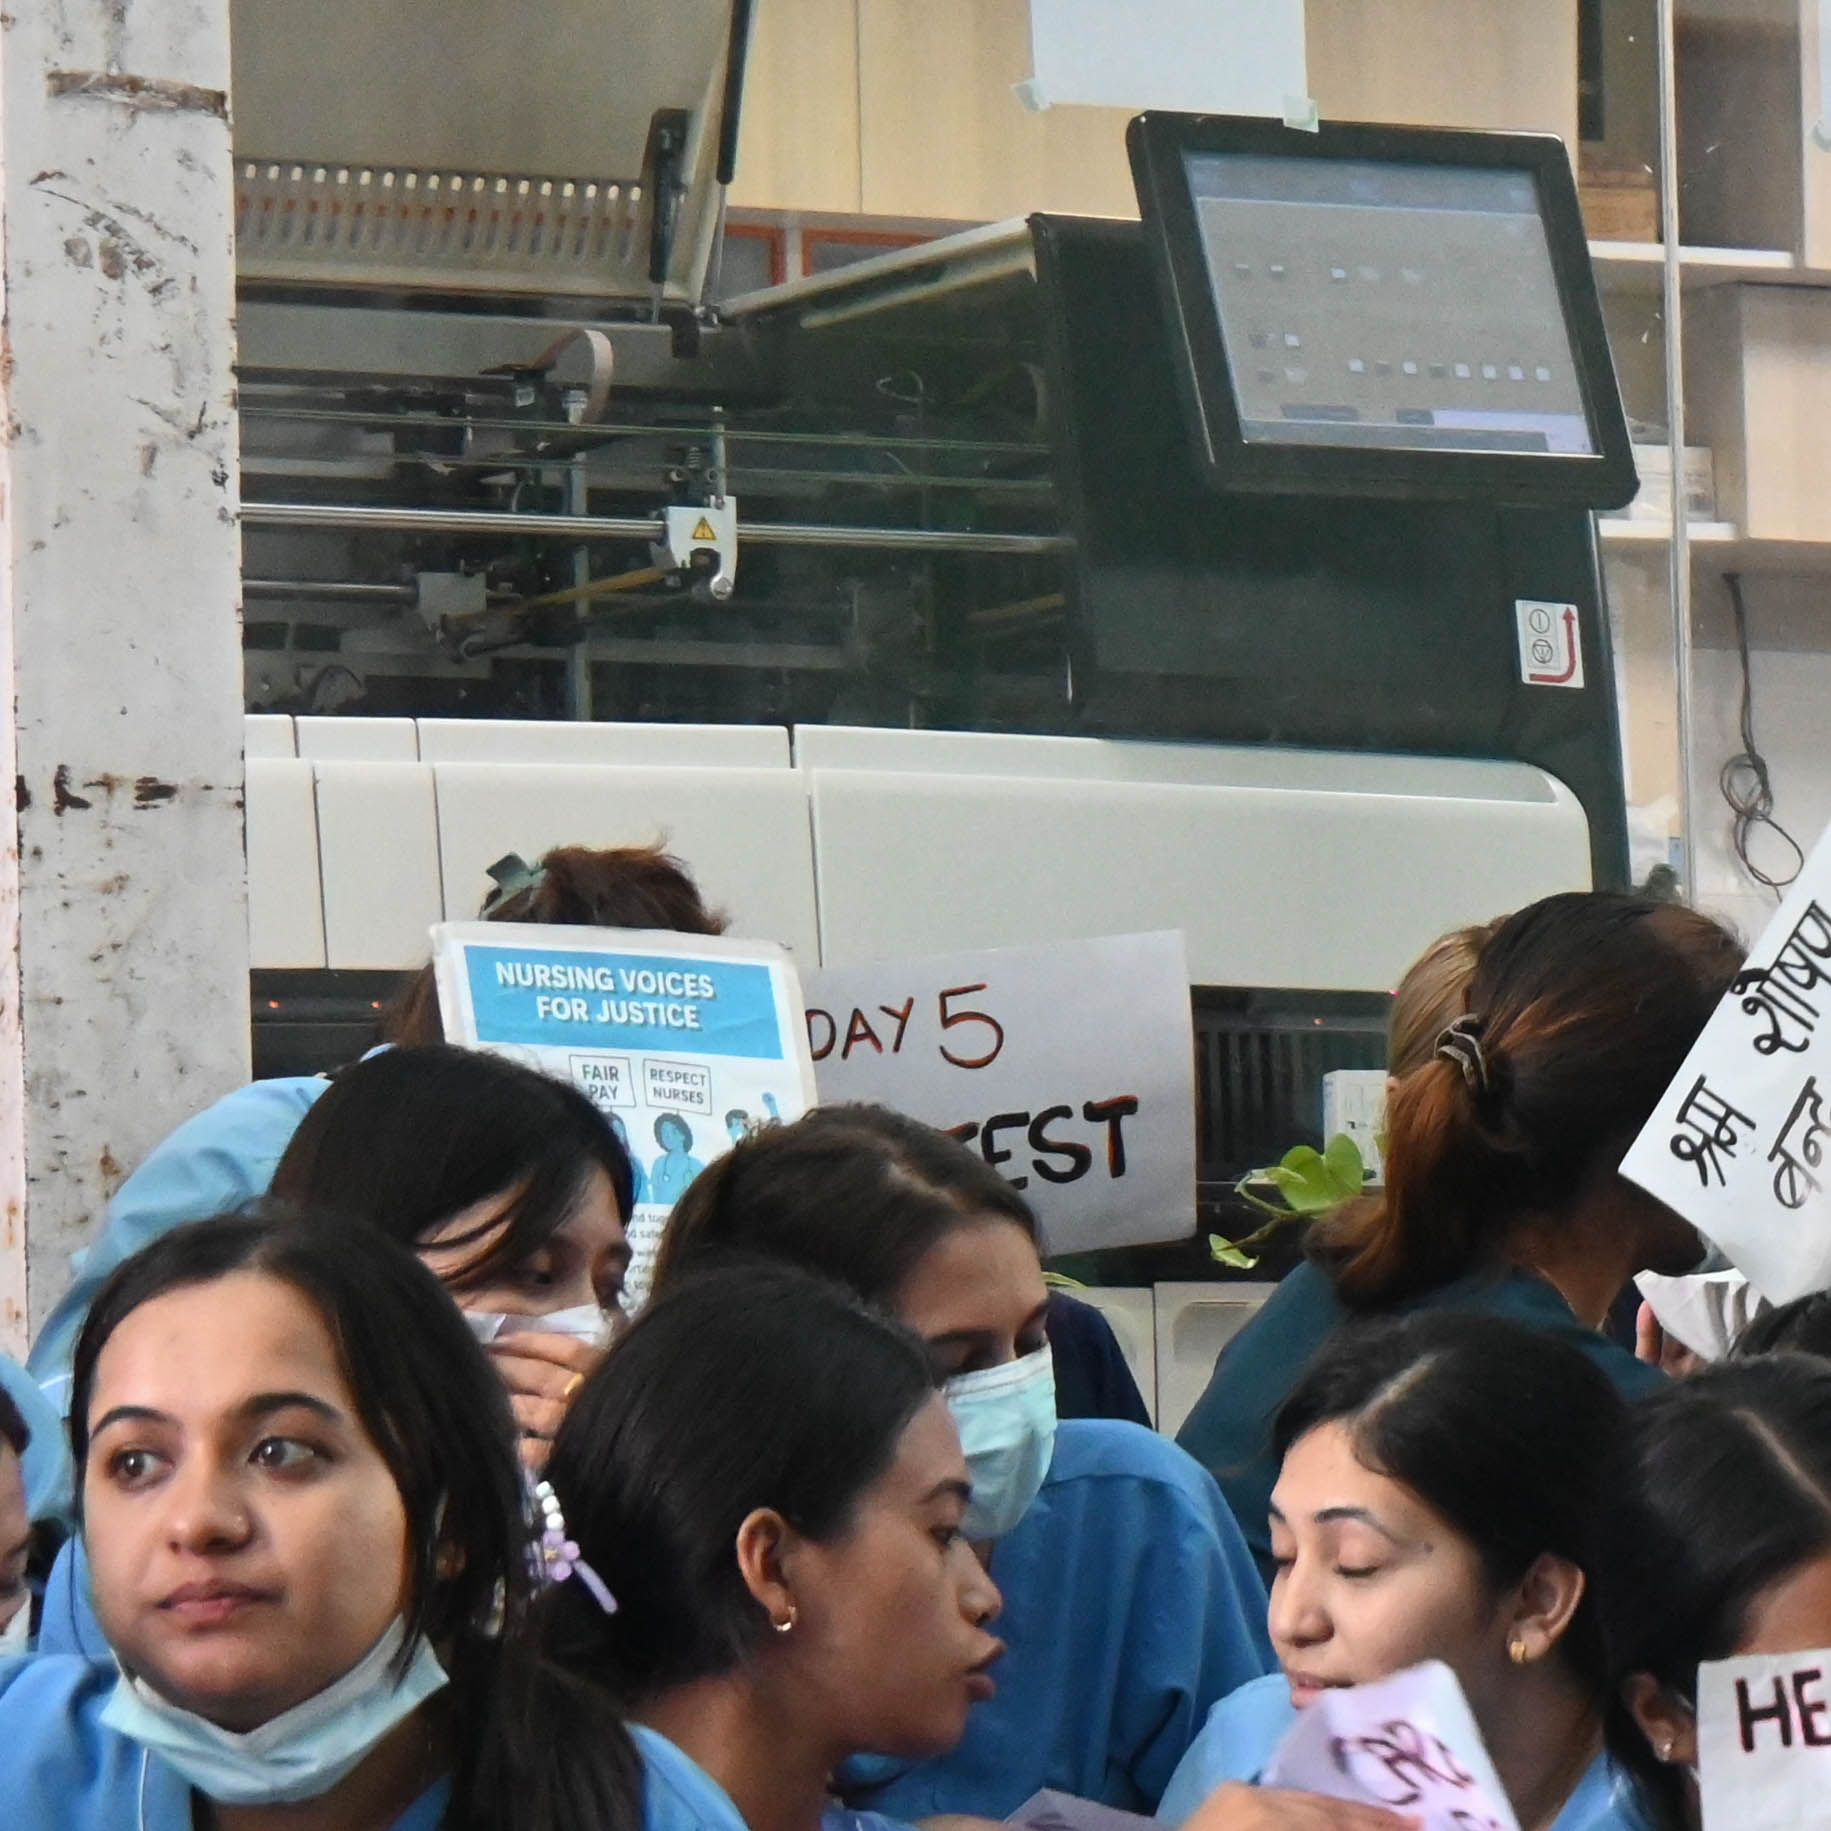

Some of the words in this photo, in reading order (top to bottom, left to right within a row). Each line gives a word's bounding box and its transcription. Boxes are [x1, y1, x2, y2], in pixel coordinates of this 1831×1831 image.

[495, 961, 616, 992] NURSING
[619, 968, 716, 999] VOICES
[536, 995, 589, 1022] FOR
[596, 999, 702, 1029] JUSTICE
[804, 996, 915, 1062] DAY
[938, 983, 1005, 1070] 5
[581, 1063, 620, 1082] FAIR
[649, 1067, 706, 1088] RESPECT
[588, 1084, 619, 1101] PAY
[652, 1085, 705, 1105] NURSES
[1669, 1073, 1757, 1188] श्रम
